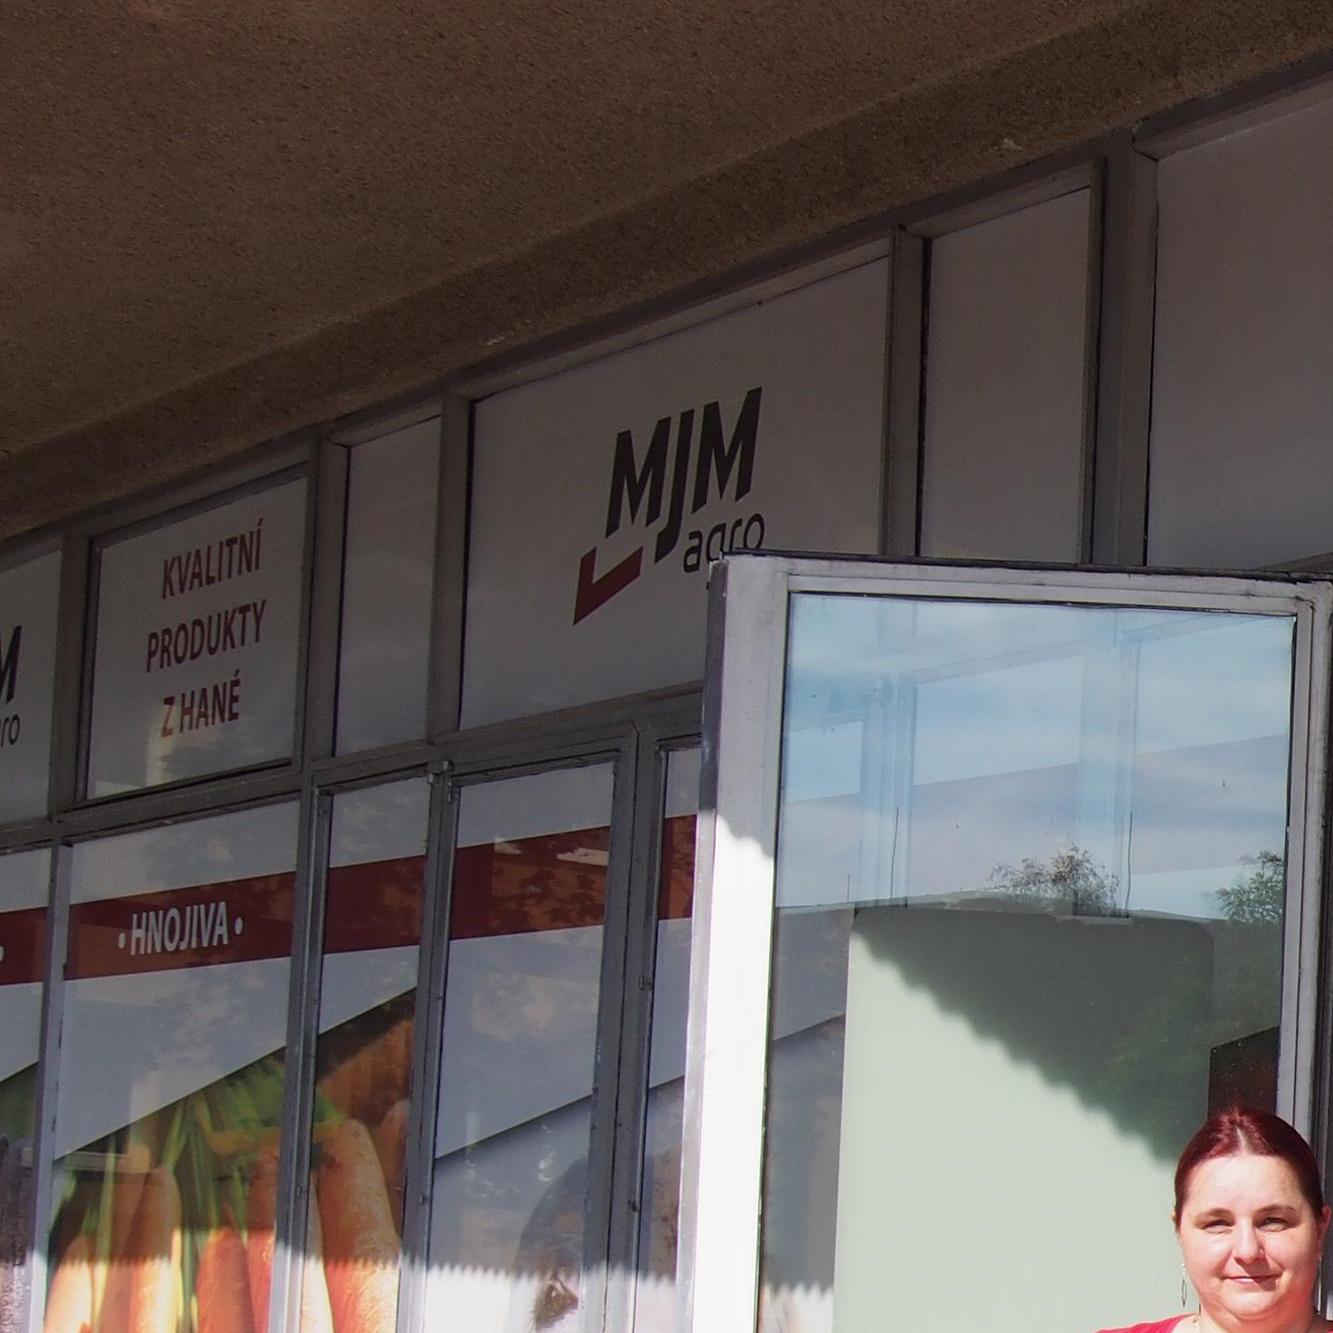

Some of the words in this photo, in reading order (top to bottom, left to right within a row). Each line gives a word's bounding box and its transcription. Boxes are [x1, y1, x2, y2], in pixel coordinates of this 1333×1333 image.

[605, 386, 763, 565] MJM
[161, 517, 264, 600] KVALITNÍ
[145, 599, 267, 673] PRODUKTY
[160, 696, 177, 738] Z
[179, 668, 241, 733] HANÉ
[130, 900, 229, 956] HNOJIVA
